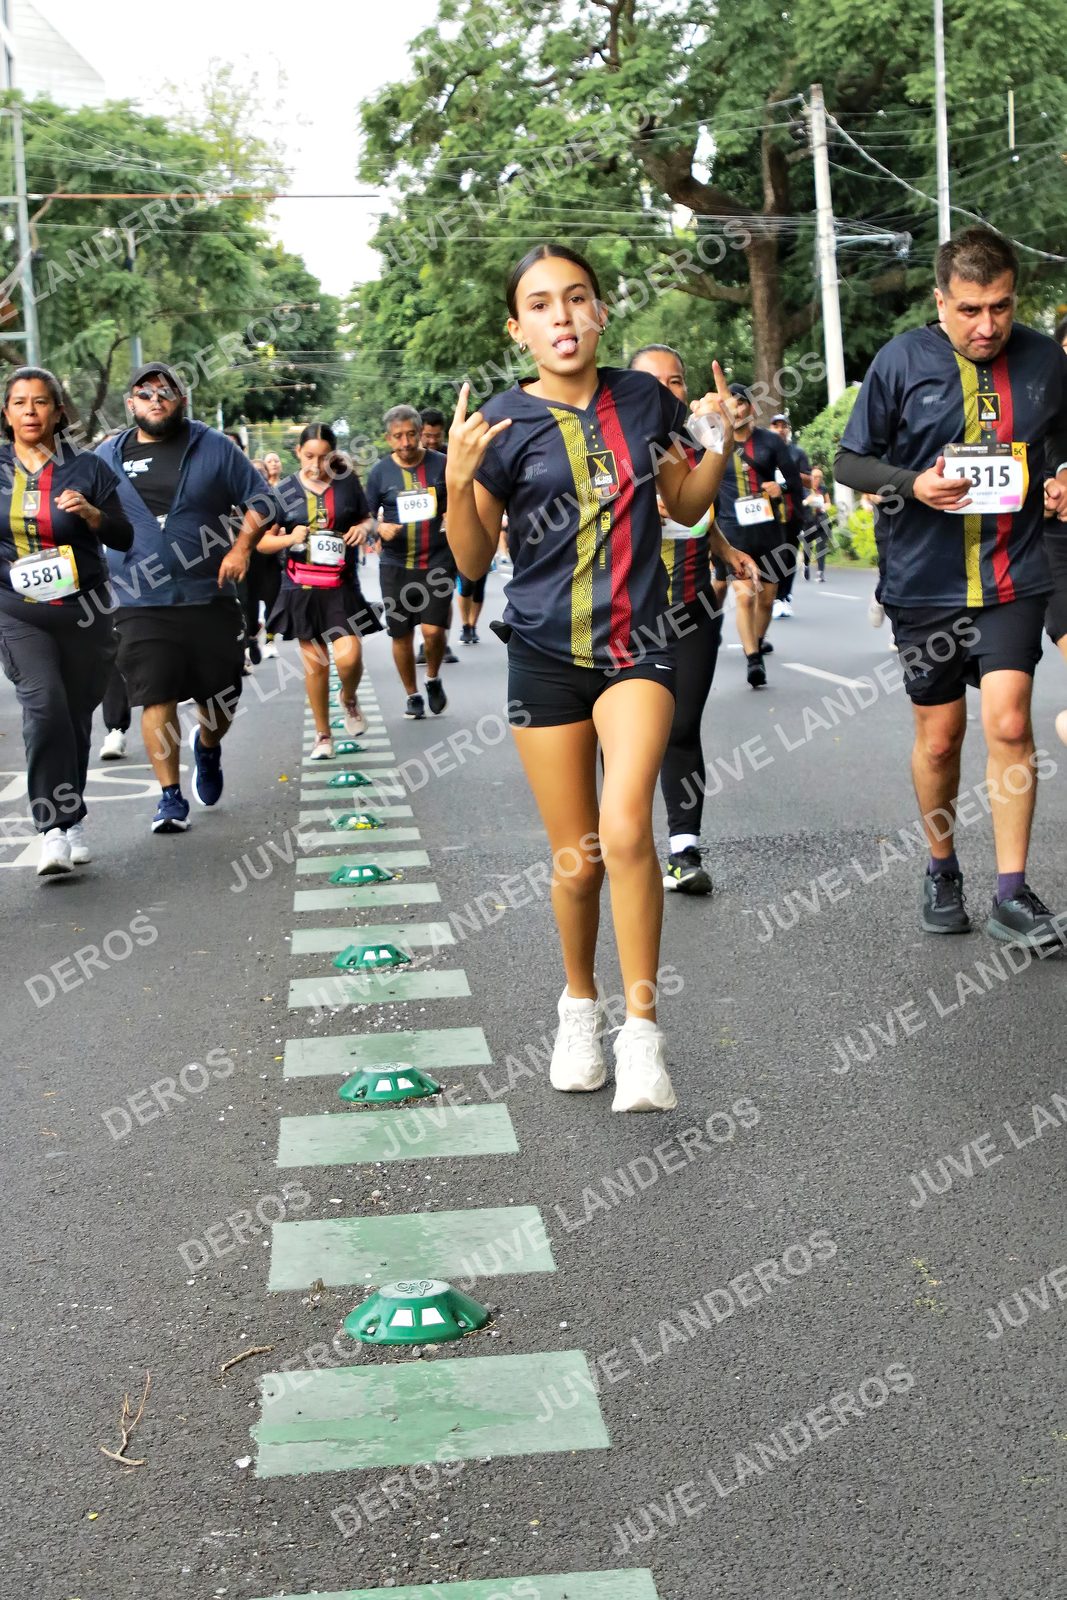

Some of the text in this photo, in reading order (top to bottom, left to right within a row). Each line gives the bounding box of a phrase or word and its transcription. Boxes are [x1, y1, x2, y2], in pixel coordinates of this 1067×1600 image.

[955, 465, 1011, 488] 1315
[403, 498, 428, 510] 6963
[744, 502, 762, 514] 626
[317, 540, 343, 554] 6580
[20, 564, 62, 589] 3581
